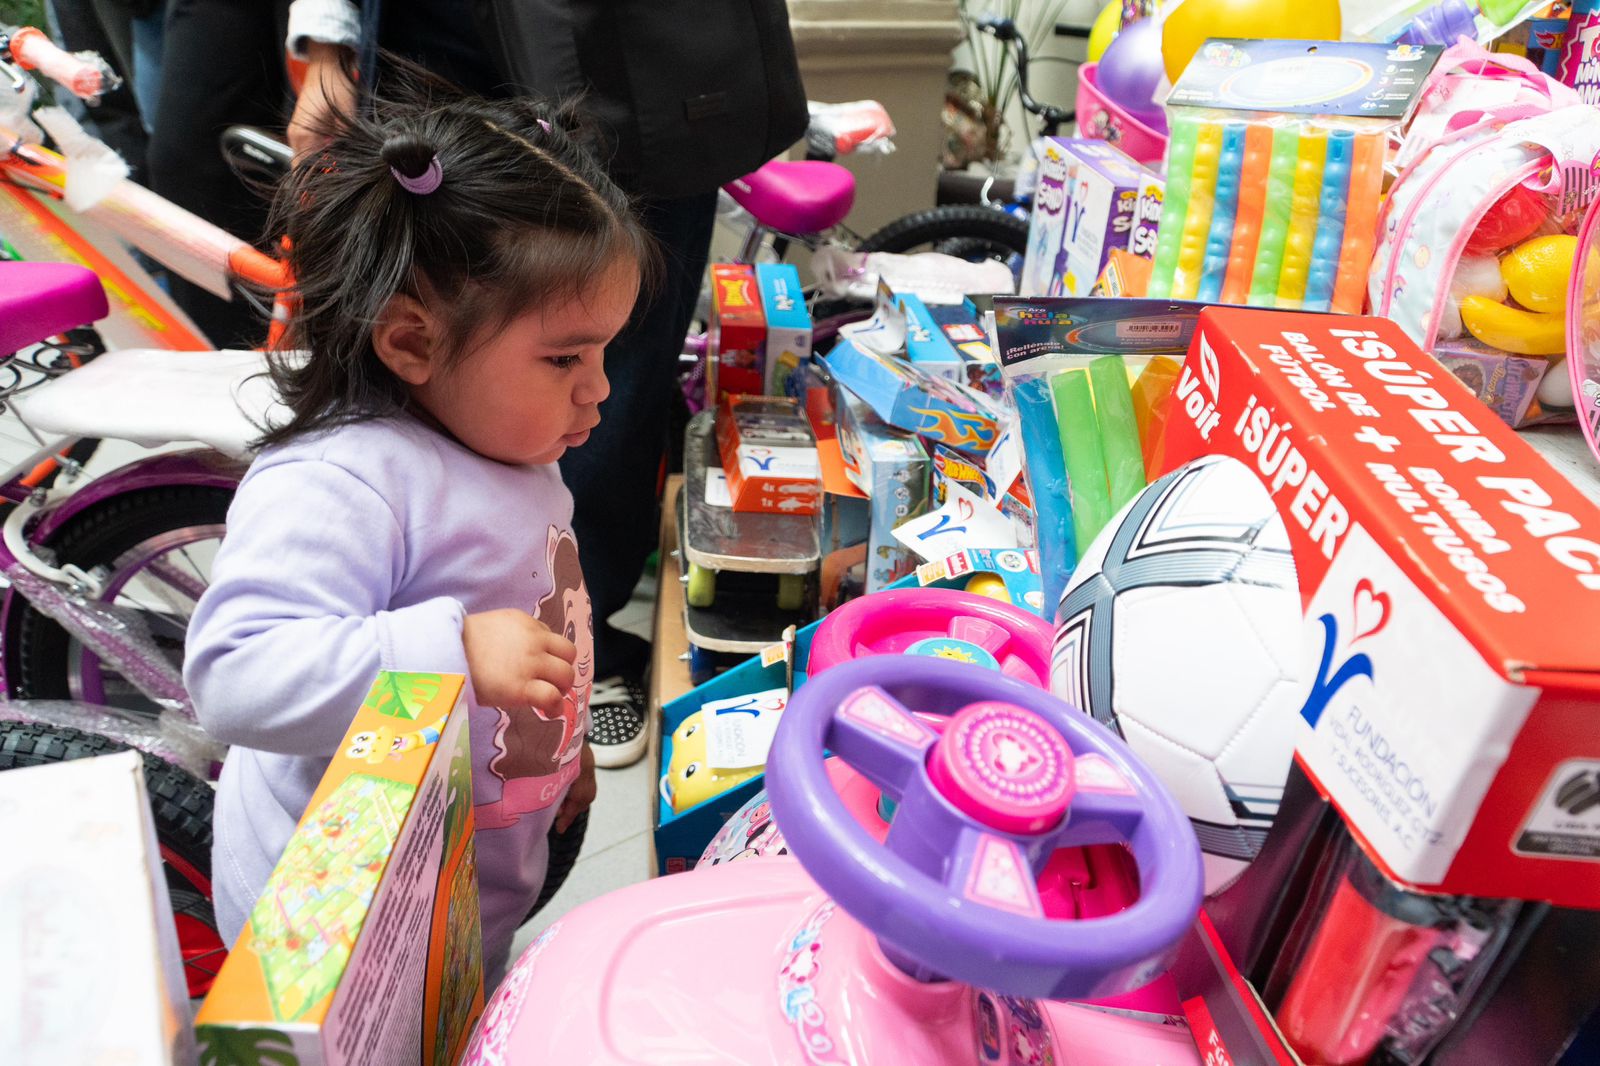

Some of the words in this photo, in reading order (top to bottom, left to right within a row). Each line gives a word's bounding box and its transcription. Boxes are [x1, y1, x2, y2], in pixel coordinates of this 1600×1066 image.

[1174, 364, 1222, 441] Voit
[1259, 343, 1337, 413] FÚTBOL
[1281, 330, 1352, 389] BALÓN
[1336, 390, 1382, 419] DE
[1233, 393, 1350, 560] ¡SÚPER
[1328, 328, 1507, 464] ¡SÚPER
[1475, 476, 1600, 590] PAC
[1364, 462, 1527, 614] MULTIUSOS
[1407, 466, 1512, 555] BOMBA
